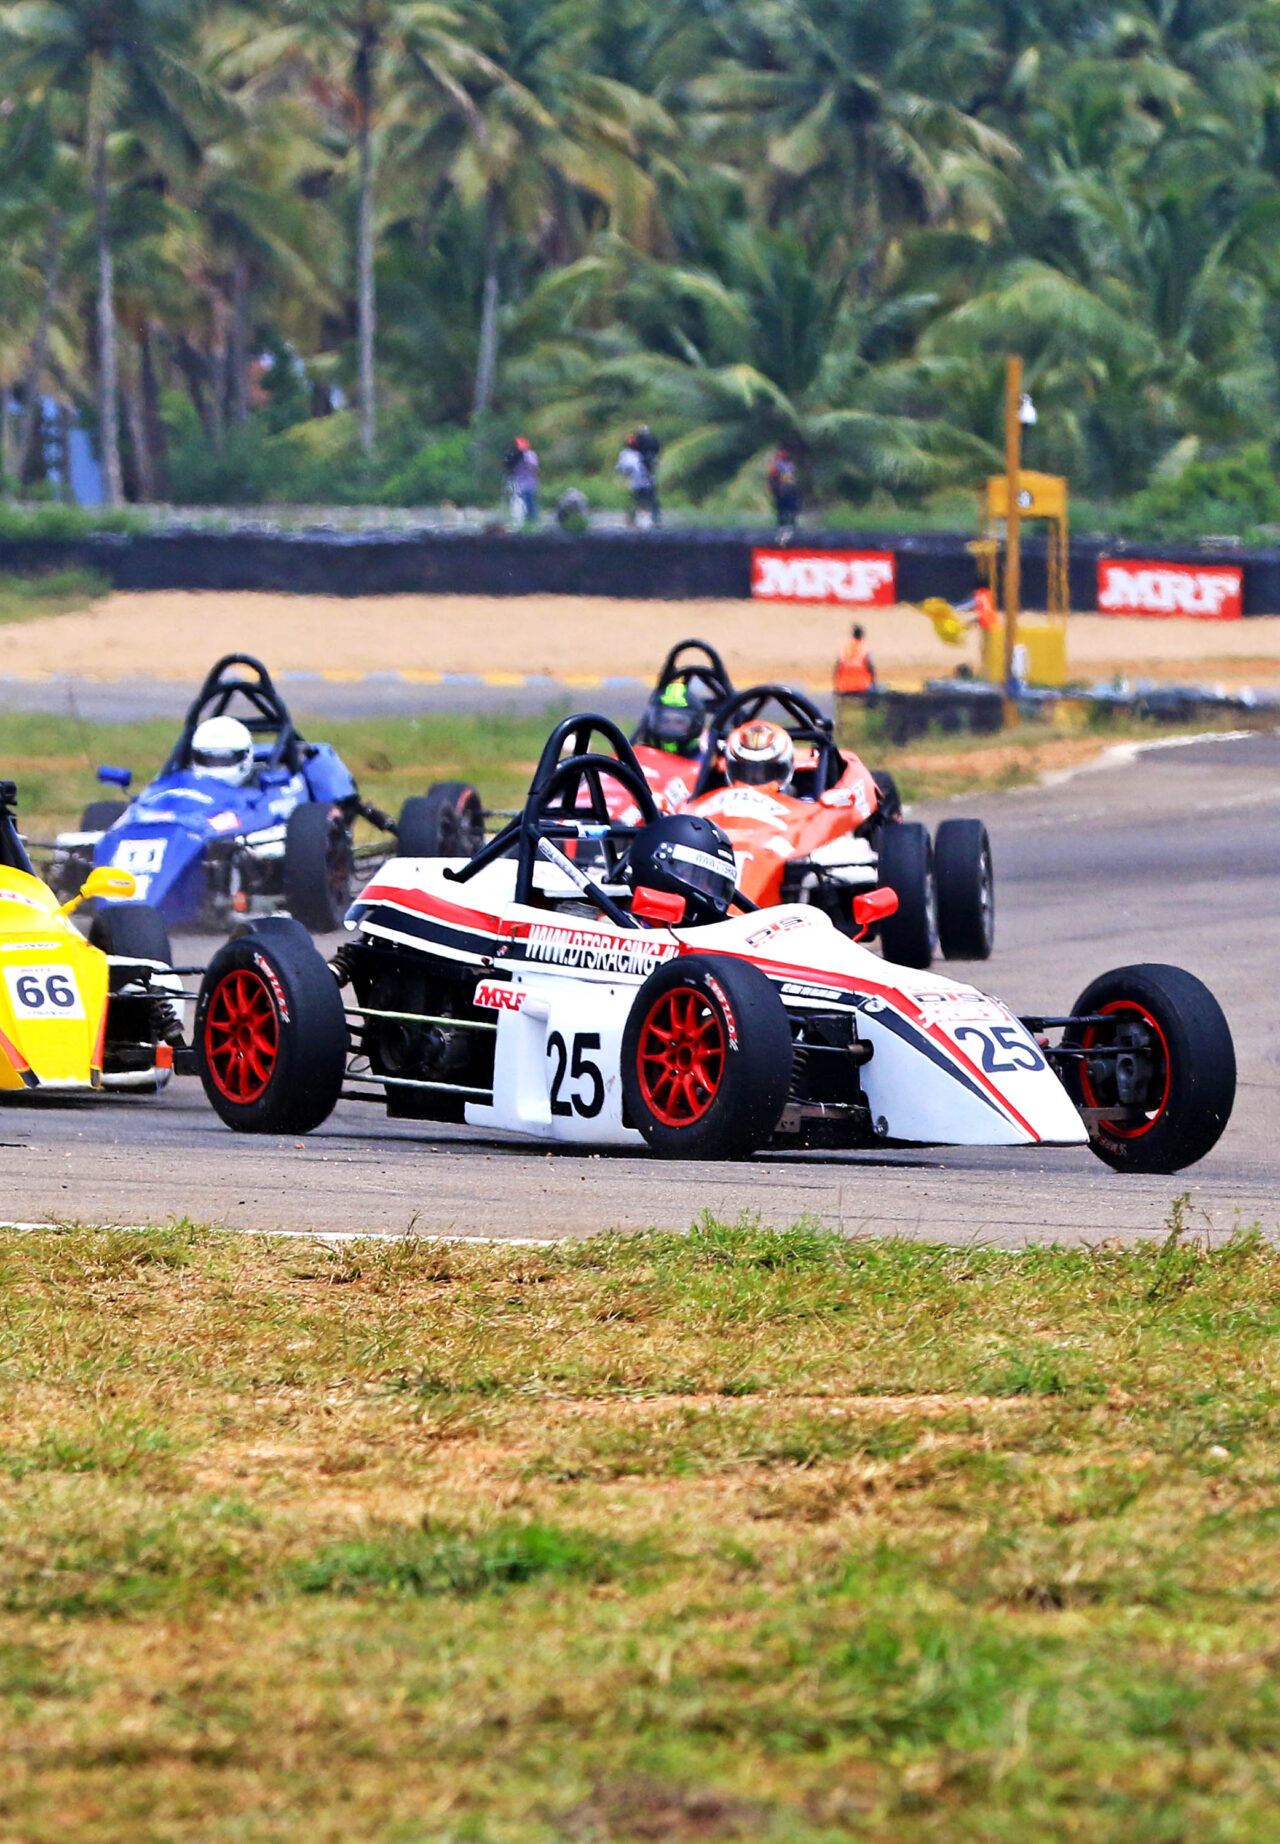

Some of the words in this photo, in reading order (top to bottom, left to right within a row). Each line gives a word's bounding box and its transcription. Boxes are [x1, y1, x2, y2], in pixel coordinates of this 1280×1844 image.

[754, 556, 893, 600] MRF
[1098, 566, 1241, 615] MRF
[16, 974, 75, 1008] 66
[475, 985, 526, 1011] MRF
[954, 1026, 1045, 1073] 25
[546, 1030, 605, 1119] 25
